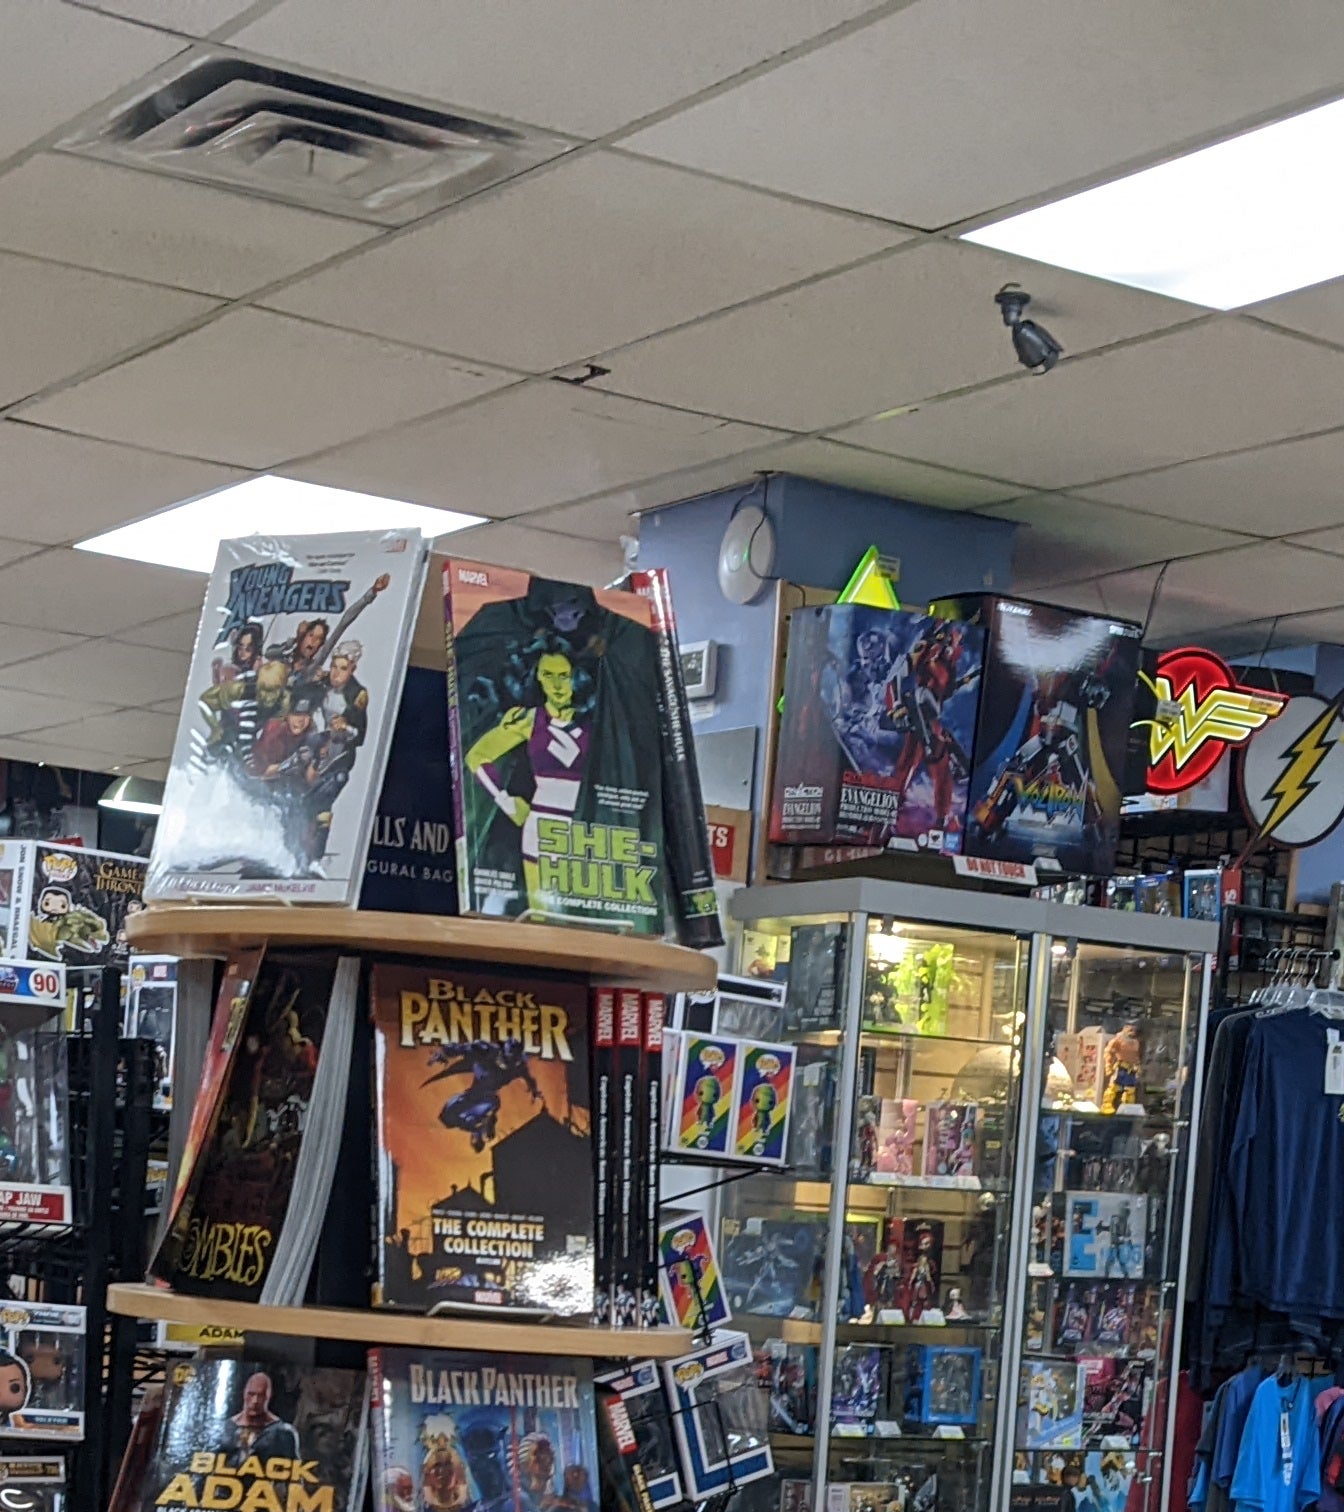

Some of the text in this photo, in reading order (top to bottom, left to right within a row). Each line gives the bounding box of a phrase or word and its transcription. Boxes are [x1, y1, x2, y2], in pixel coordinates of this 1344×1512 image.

[230, 562, 295, 598] YOUNG
[459, 568, 488, 586] MARVEL
[840, 788, 900, 809] EVANGELION
[410, 821, 449, 855] AND
[537, 817, 657, 862] SHE-
[100, 862, 139, 880] GAME
[423, 864, 454, 883] BAG
[537, 856, 658, 905] HULK
[979, 859, 1000, 873] NOT
[556, 897, 658, 916] COMPLETE COLLECTION
[33, 972, 58, 994] 90
[428, 977, 538, 1011] BLACK
[400, 995, 573, 1062] PANTHER
[597, 993, 613, 1042] MARVEL
[621, 993, 639, 1042] MARVEL
[647, 998, 663, 1048] MARVEL
[13, 1191, 43, 1207] JAW
[431, 1217, 545, 1243] THE COMPLETE
[443, 1237, 534, 1259] COLLECTION
[198, 1326, 244, 1343] ADAM
[410, 1364, 581, 1411] BLACK PANTHER
[609, 1402, 633, 1451] MARVEL
[189, 1451, 321, 1484] BLACK
